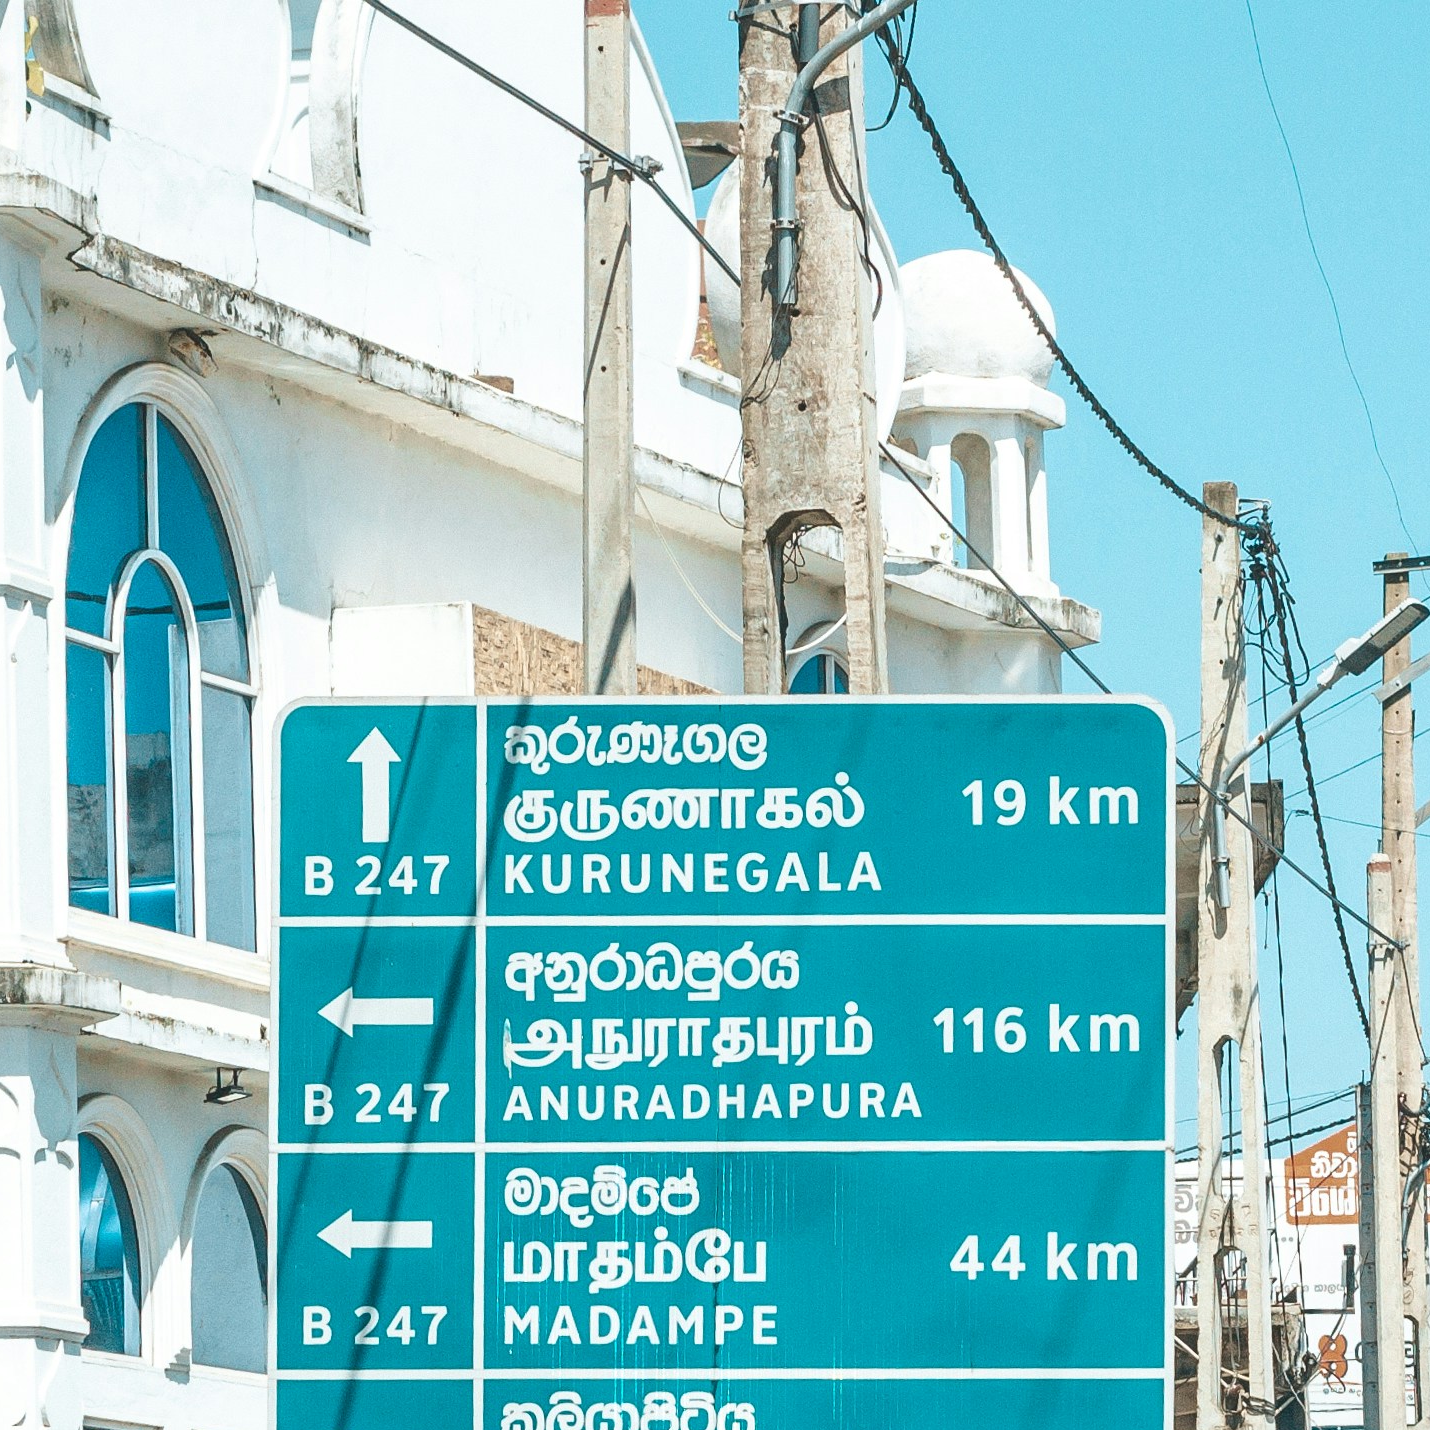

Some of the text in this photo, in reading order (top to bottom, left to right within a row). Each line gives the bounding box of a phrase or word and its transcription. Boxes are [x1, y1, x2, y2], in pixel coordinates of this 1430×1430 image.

[504, 716, 768, 775] කුරුණෑගල
[503, 771, 865, 842] குருணாகல்
[962, 776, 1139, 826] 19 km
[304, 855, 450, 896] B 247
[504, 851, 882, 894] KURUNEGALA
[504, 941, 800, 1002] අනුරාධපුරය
[503, 1000, 873, 1077] அநுராதபுரம்
[934, 1004, 1140, 1053] 116 km
[304, 1083, 450, 1125] B 247
[502, 1082, 922, 1121] ANURADHAPURA
[504, 1165, 700, 1228] මාදම්පේ
[503, 1226, 767, 1294] மாதம்பே
[949, 1232, 1138, 1281] 44 km
[302, 1305, 448, 1345] B 247
[504, 1305, 778, 1345] MADAMPE
